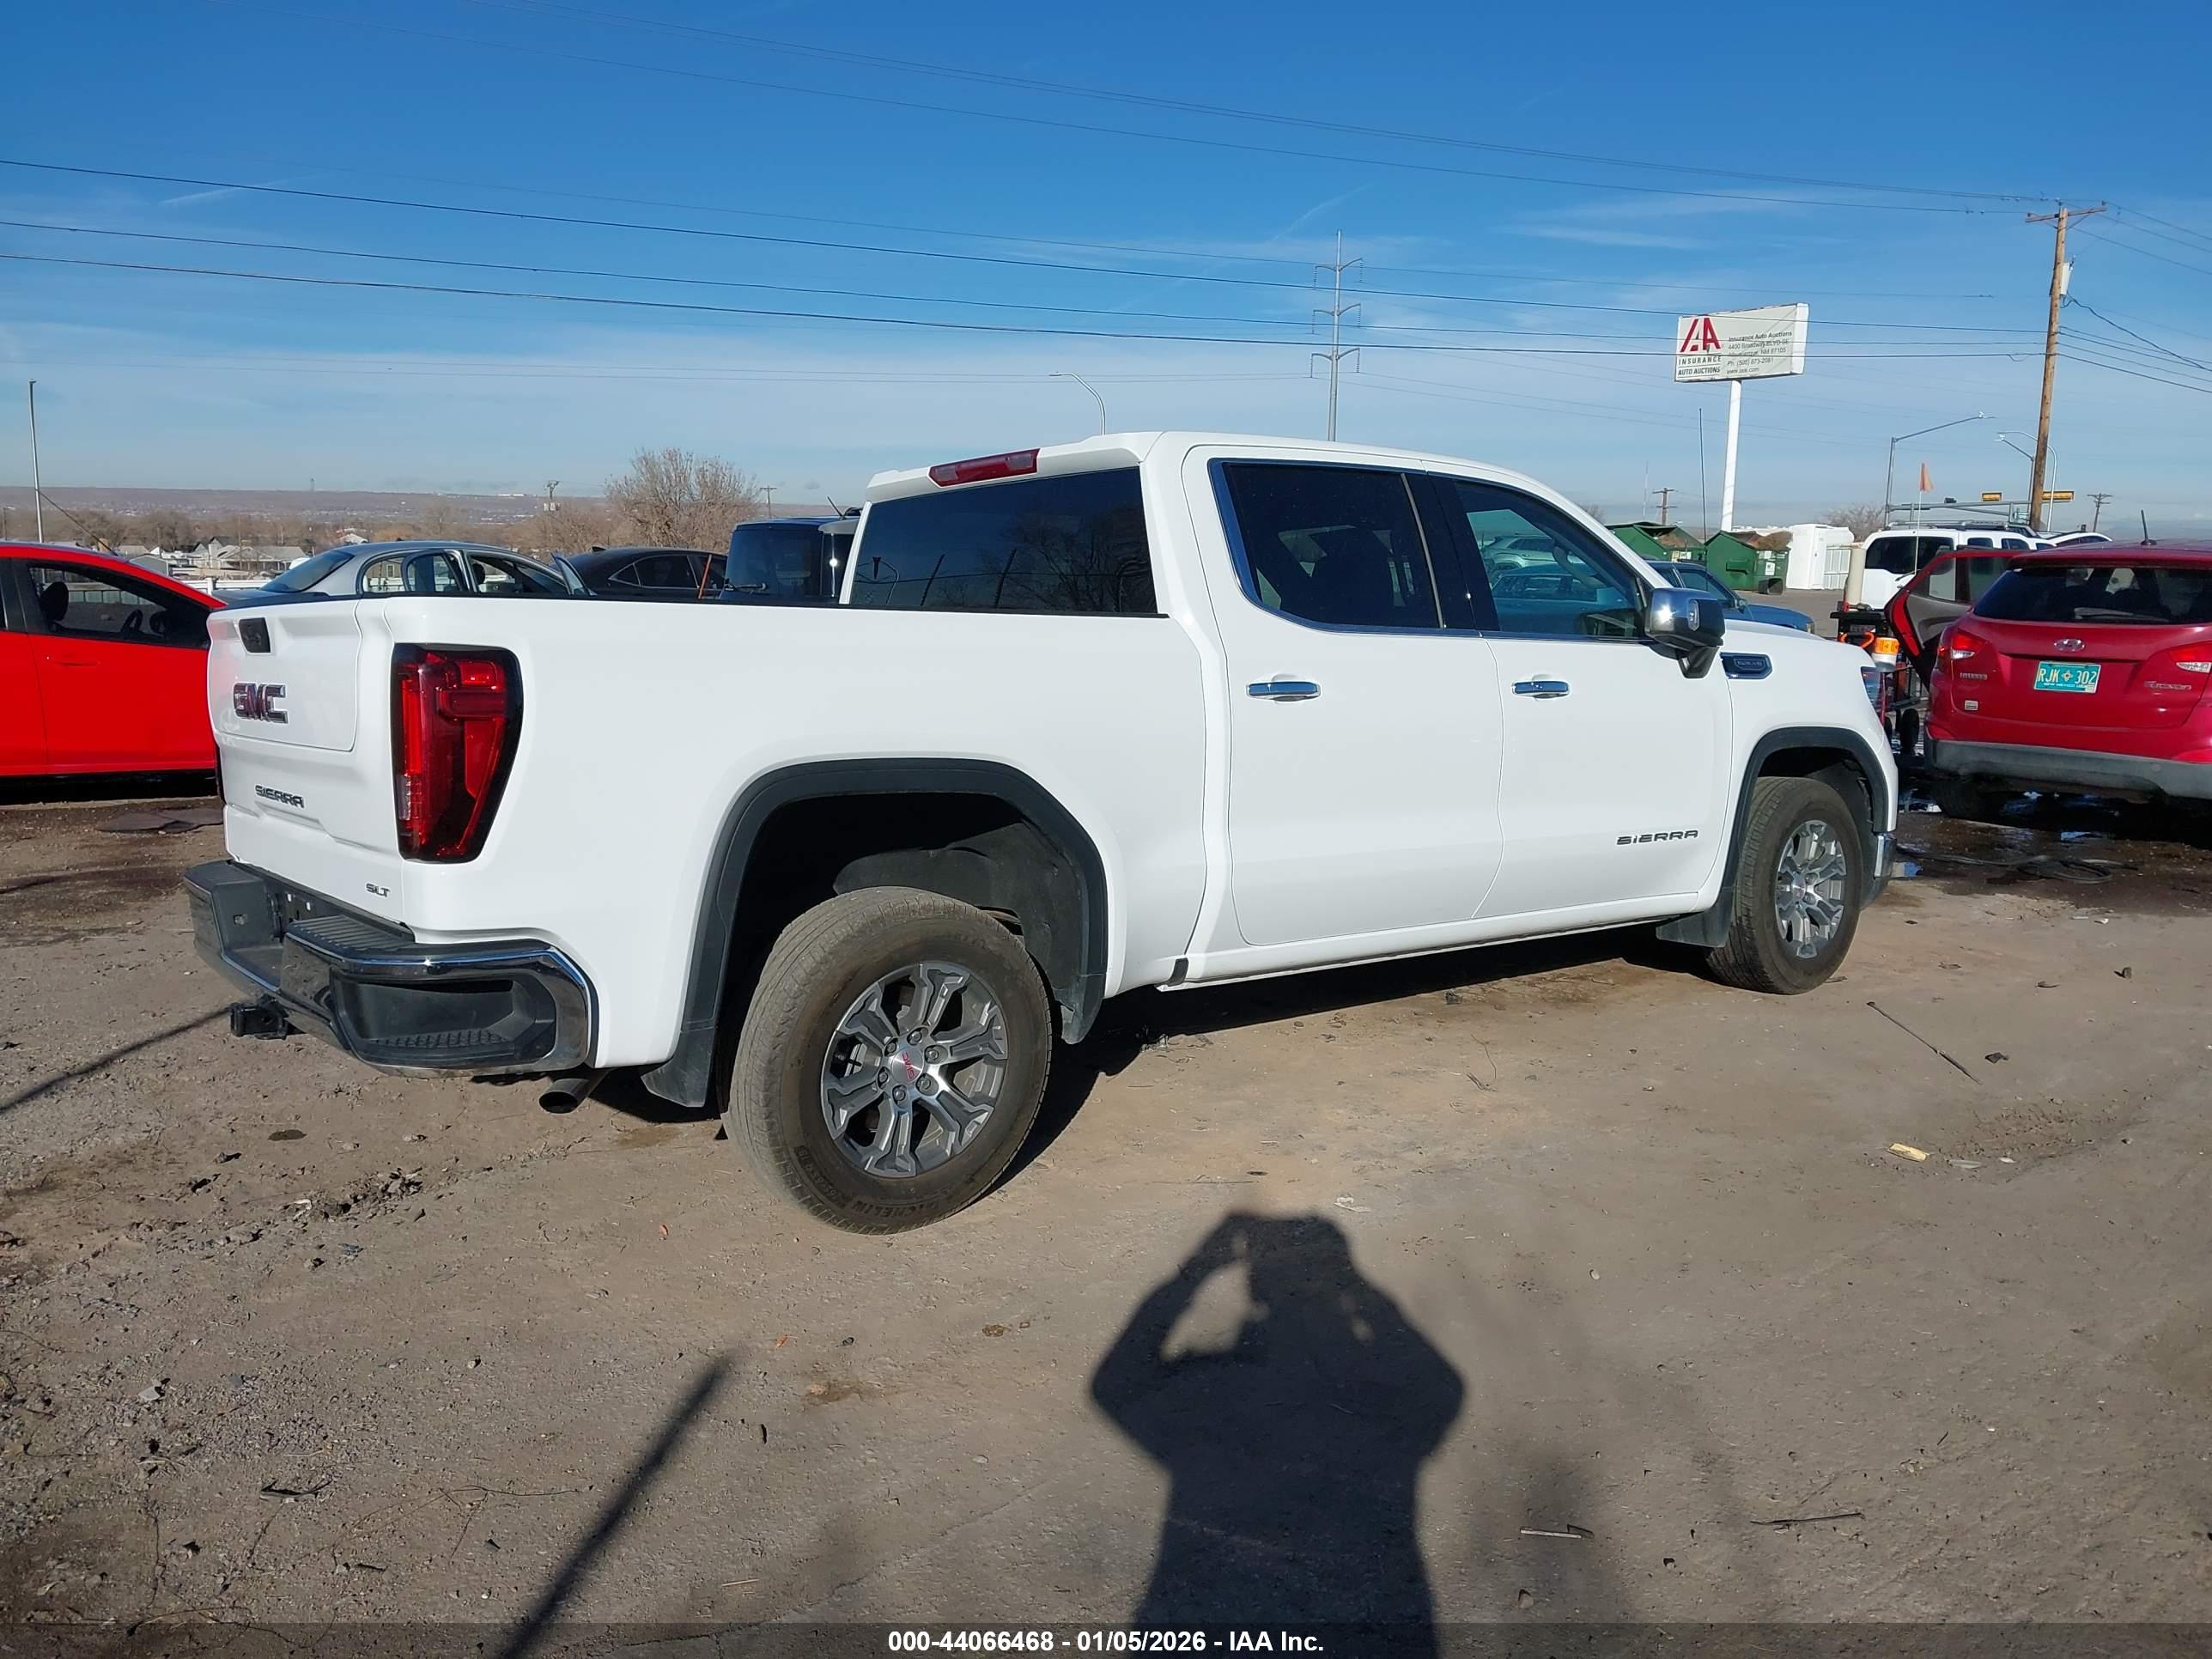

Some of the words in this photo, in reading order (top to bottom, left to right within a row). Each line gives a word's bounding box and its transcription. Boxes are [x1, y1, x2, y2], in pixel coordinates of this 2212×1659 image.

[1679, 356, 1722, 365] INSURANCE
[1678, 368, 1692, 376] AUTO
[1693, 366, 1721, 374] AUCTIONS
[2037, 668, 2060, 683] RJK
[2075, 670, 2098, 685] 302
[233, 683, 289, 724] GMC
[255, 784, 305, 809] SIERRA
[1616, 830, 1699, 846] SIERRA
[365, 883, 390, 898] SLT
